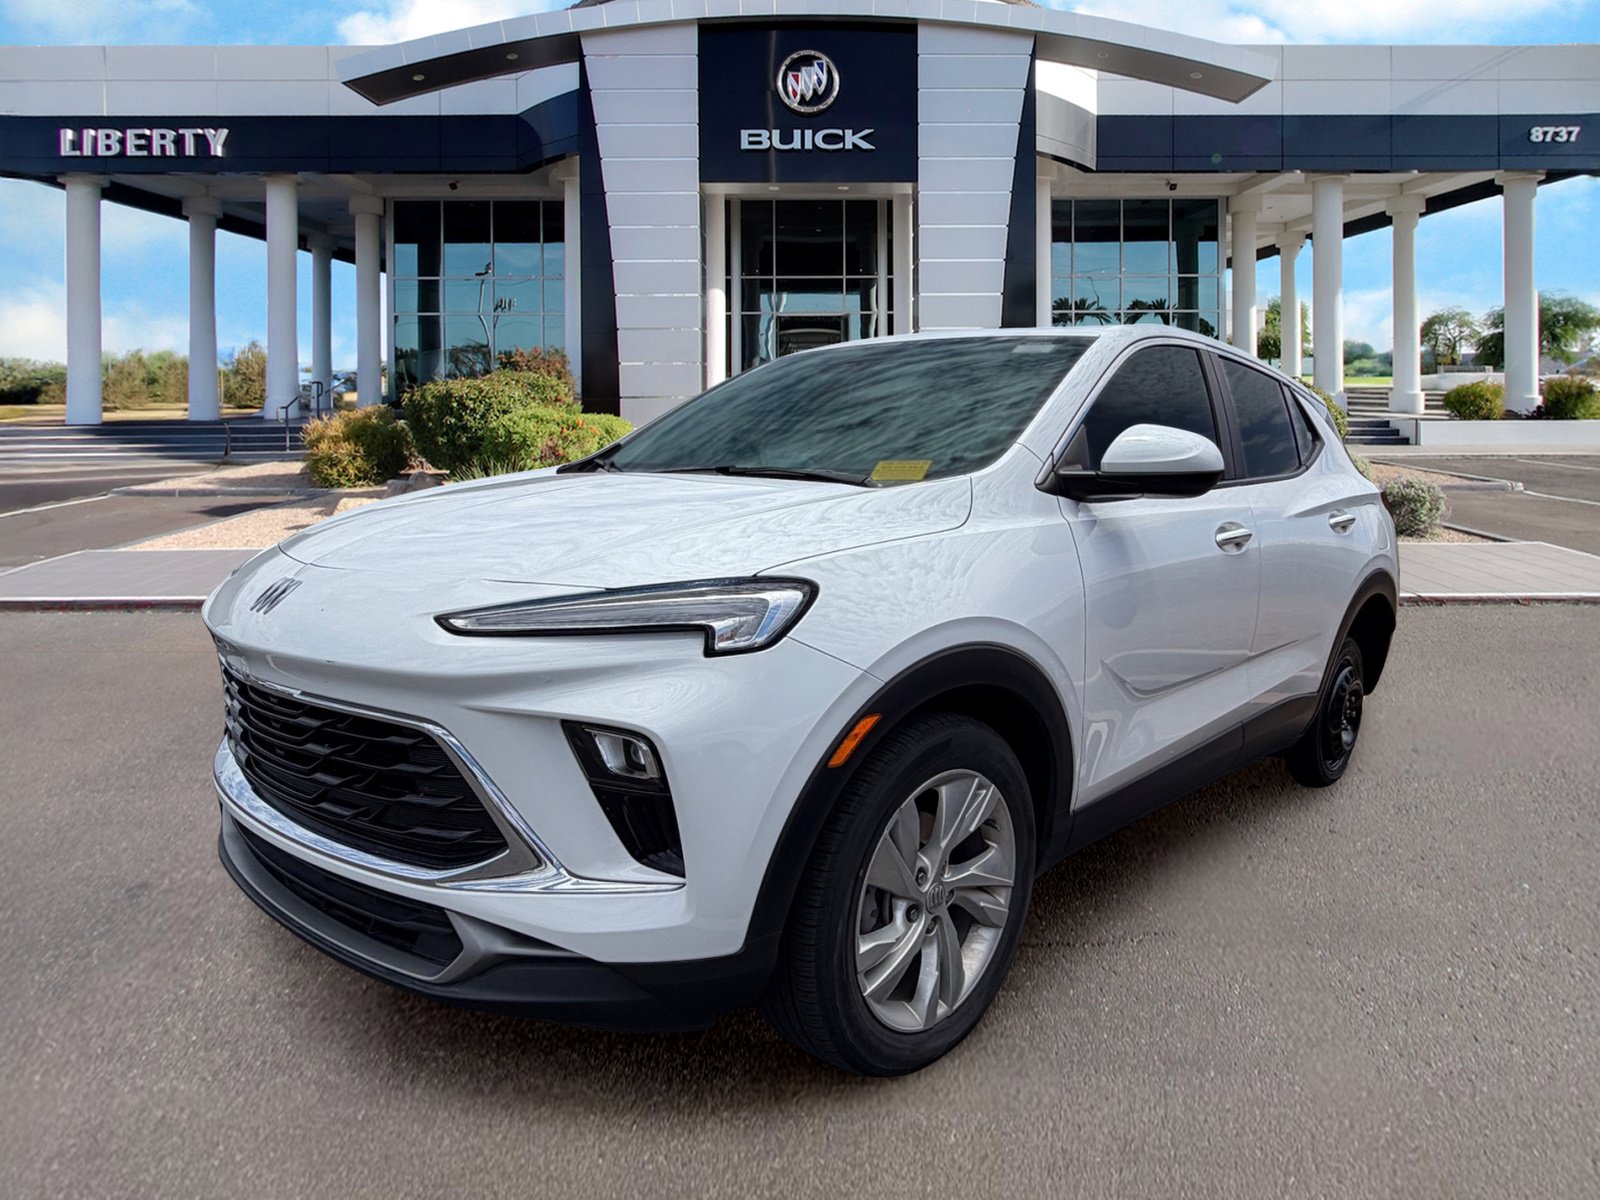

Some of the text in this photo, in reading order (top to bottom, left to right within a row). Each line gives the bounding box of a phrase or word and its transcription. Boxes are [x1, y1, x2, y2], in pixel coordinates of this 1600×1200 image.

[59, 128, 229, 157] LIBERTY
[740, 128, 876, 150] BUICK
[1529, 126, 1581, 142] 8737
